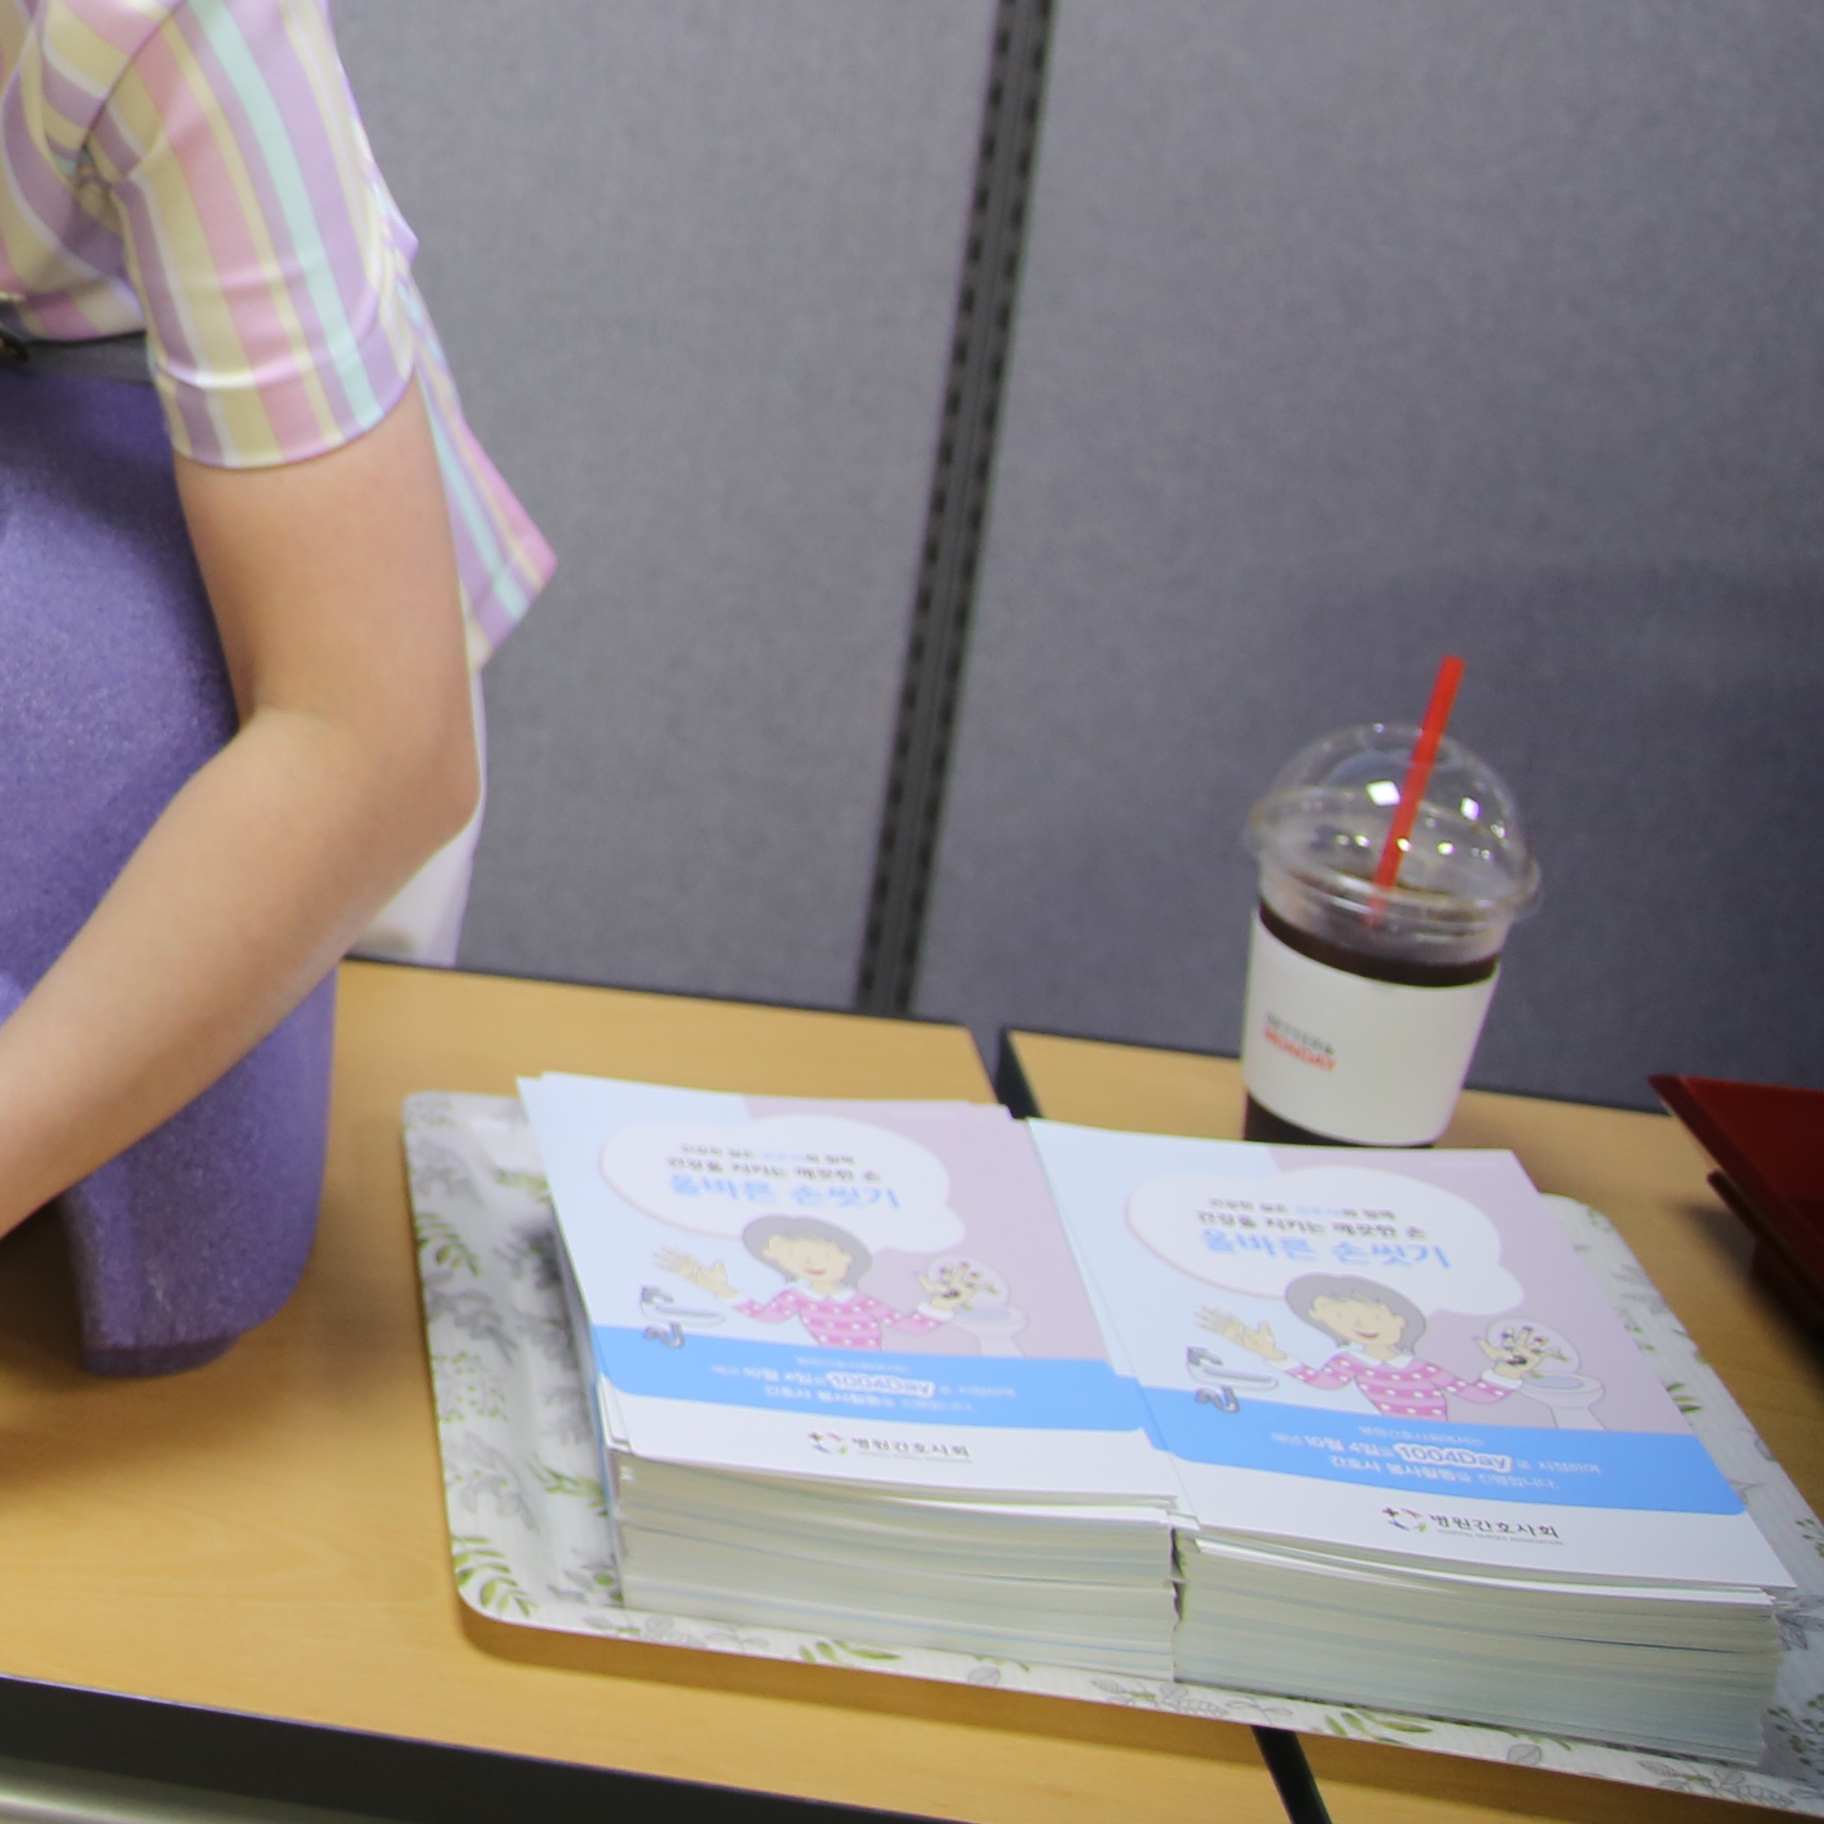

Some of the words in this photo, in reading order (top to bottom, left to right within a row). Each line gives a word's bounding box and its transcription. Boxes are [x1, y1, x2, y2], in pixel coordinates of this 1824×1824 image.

[669, 1172, 778, 1205] 올바른
[790, 1182, 903, 1210] 손씻기
[1201, 1226, 1318, 1263] 올바른
[1332, 1239, 1454, 1271] 손씻기
[1396, 1443, 1510, 1471] 1004Day
[1428, 1512, 1562, 1540] 병원간호사회
